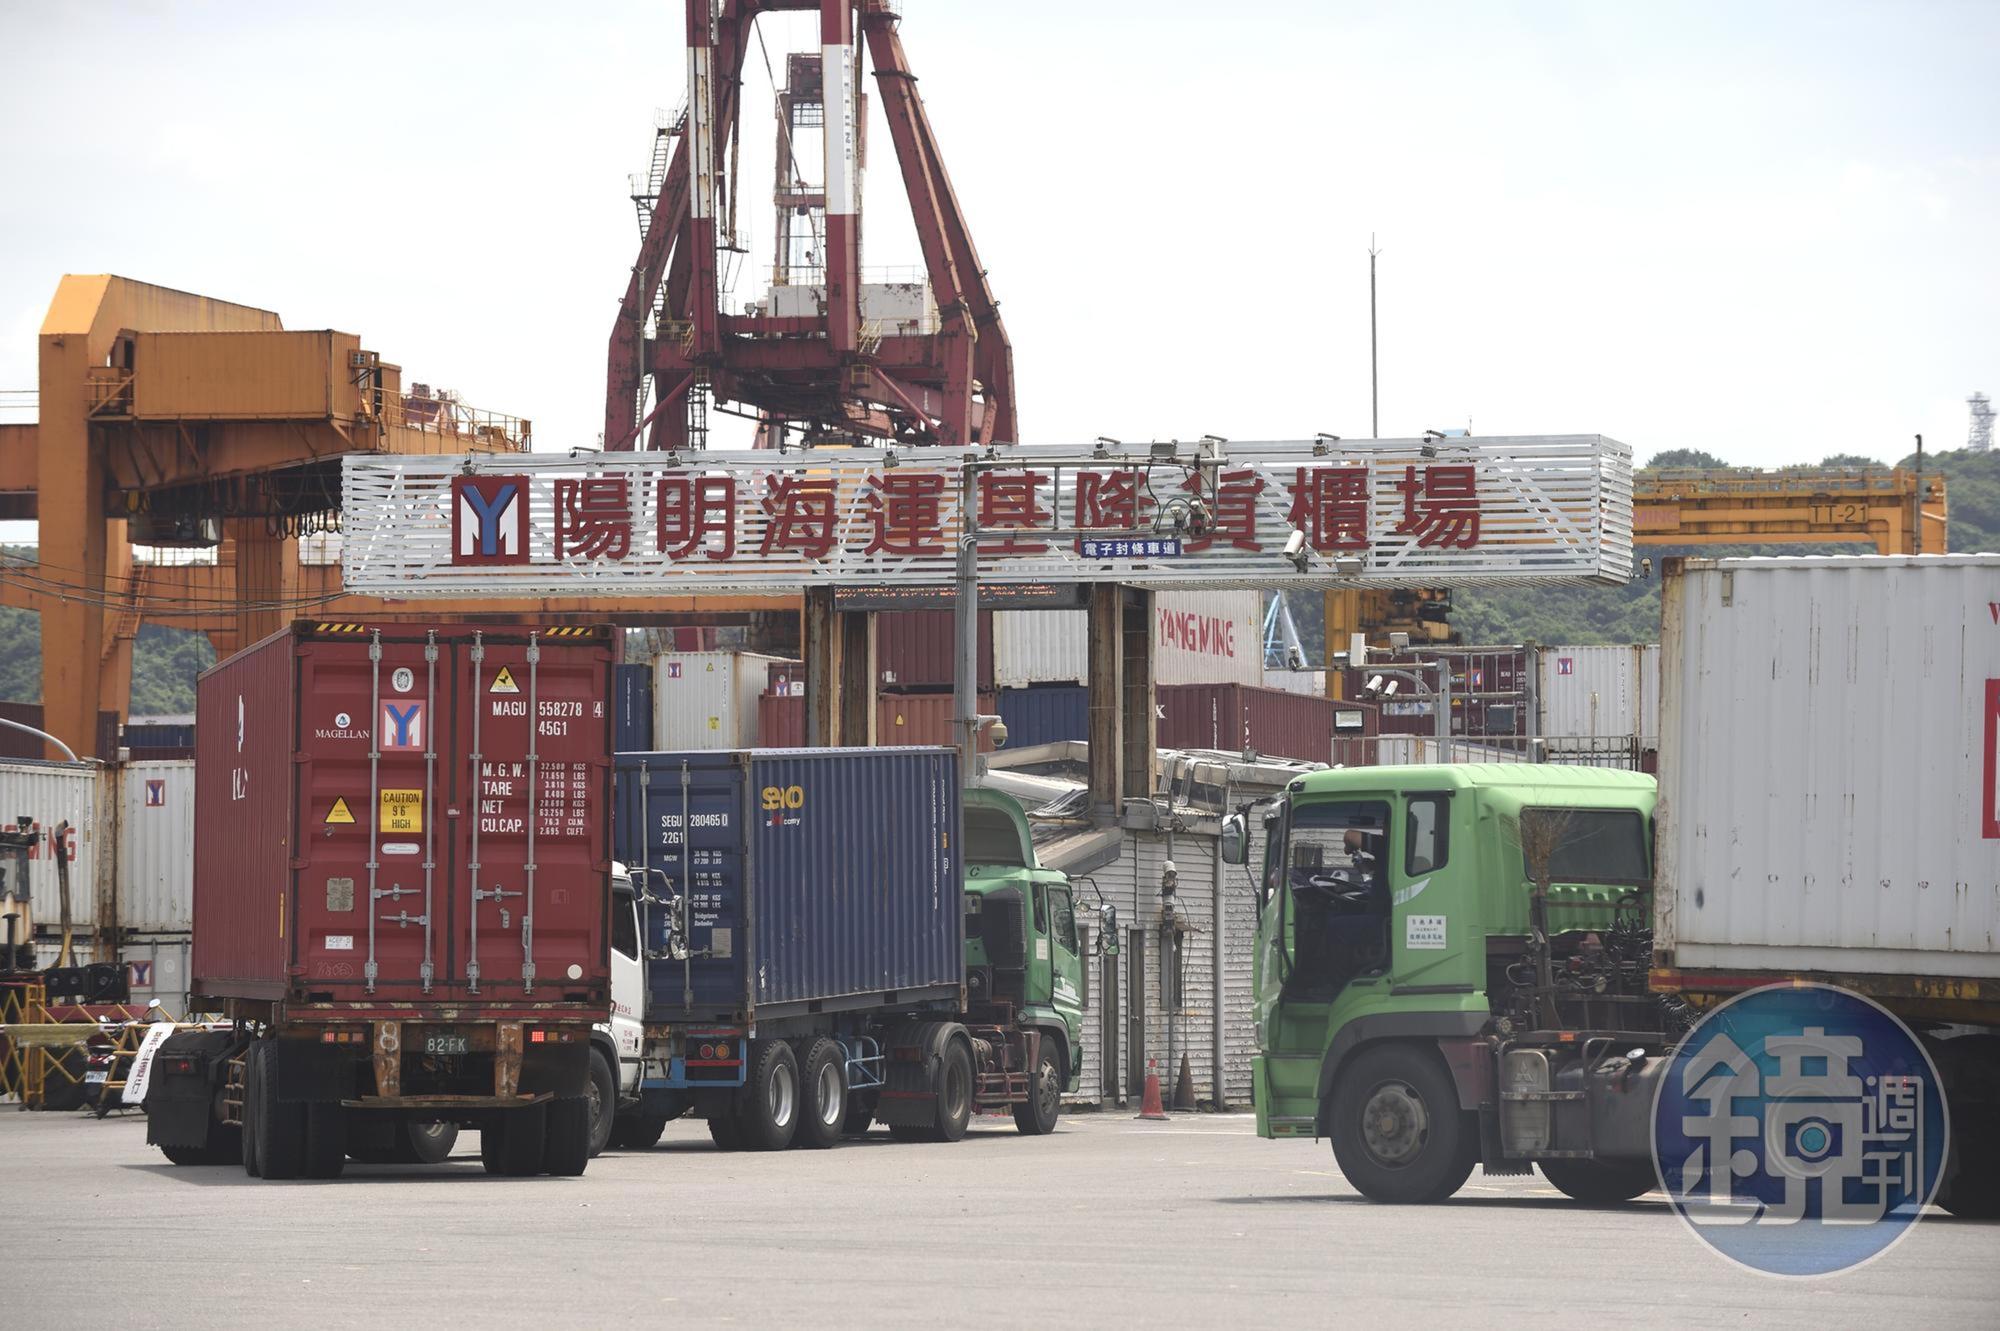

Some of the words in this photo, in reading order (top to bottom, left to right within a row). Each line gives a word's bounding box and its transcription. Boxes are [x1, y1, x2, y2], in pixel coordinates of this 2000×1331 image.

[1811, 505, 1867, 523] TT-21
[492, 701, 526, 716] MAGU
[539, 701, 582, 717] 558278
[594, 702, 602, 717] 4
[315, 729, 370, 739] MAGELLAN
[538, 721, 567, 736] 45G1
[482, 762, 526, 778] M.G.W.
[573, 772, 586, 780] LBS
[482, 781, 512, 796] TARE
[573, 781, 586, 789] KGS
[573, 790, 586, 798] LBS
[383, 792, 420, 803] CAUTION
[481, 800, 504, 814] NET
[572, 809, 585, 817] LBS
[391, 819, 411, 829] HIGH
[481, 818, 525, 833] CU.CAP.
[661, 815, 683, 828] SEGU
[690, 814, 721, 827] 280465
[662, 832, 684, 844] 22G1
[427, 1038, 466, 1053] 82-FK
